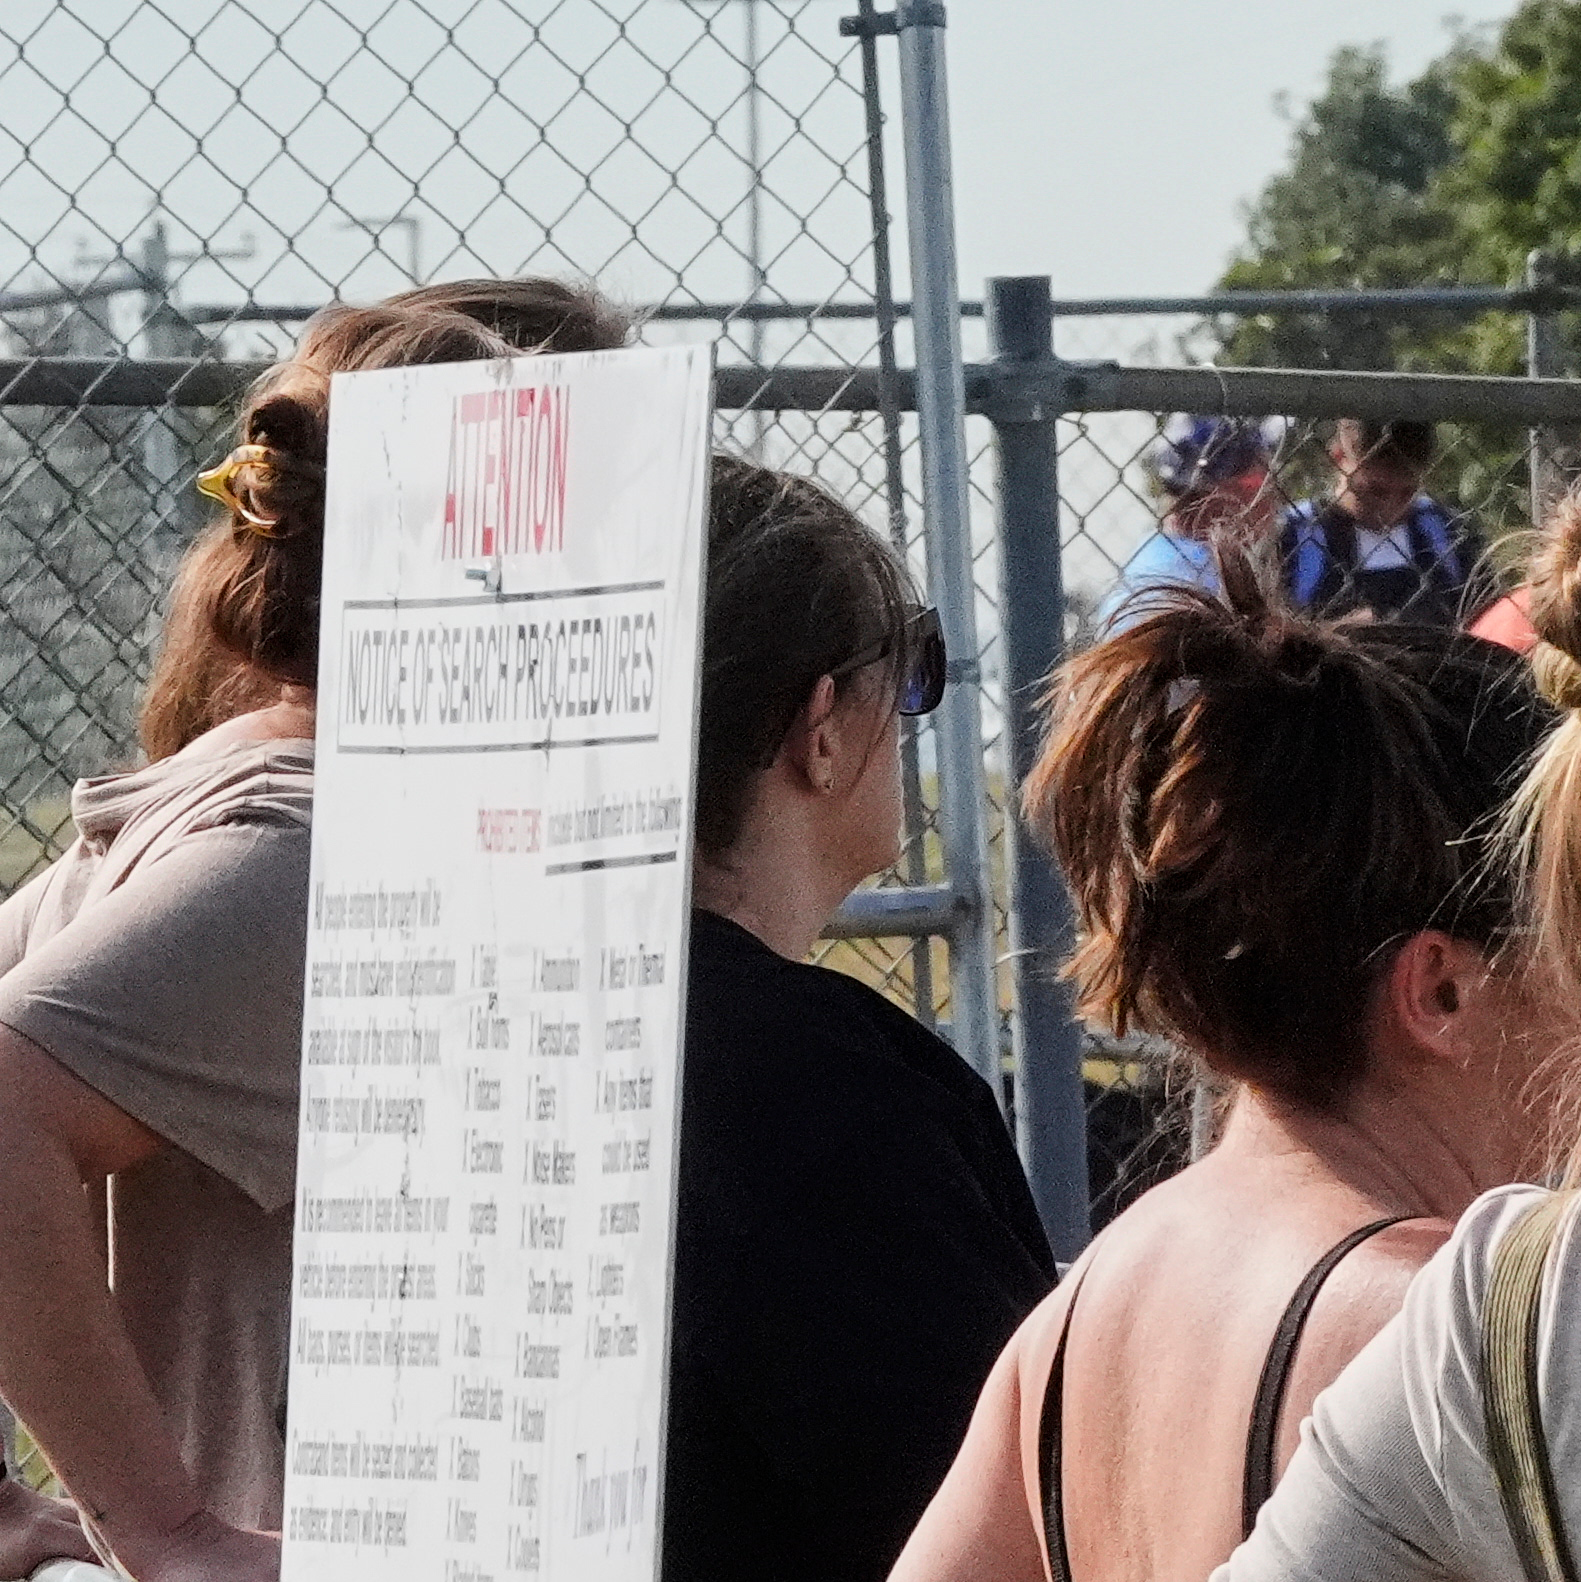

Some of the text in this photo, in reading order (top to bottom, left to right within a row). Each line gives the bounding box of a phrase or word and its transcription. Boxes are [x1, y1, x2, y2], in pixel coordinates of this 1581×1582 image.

[441, 385, 570, 562] ATTENTION
[345, 610, 656, 726] NOTICE OF SEARCH PROCEEDURES
